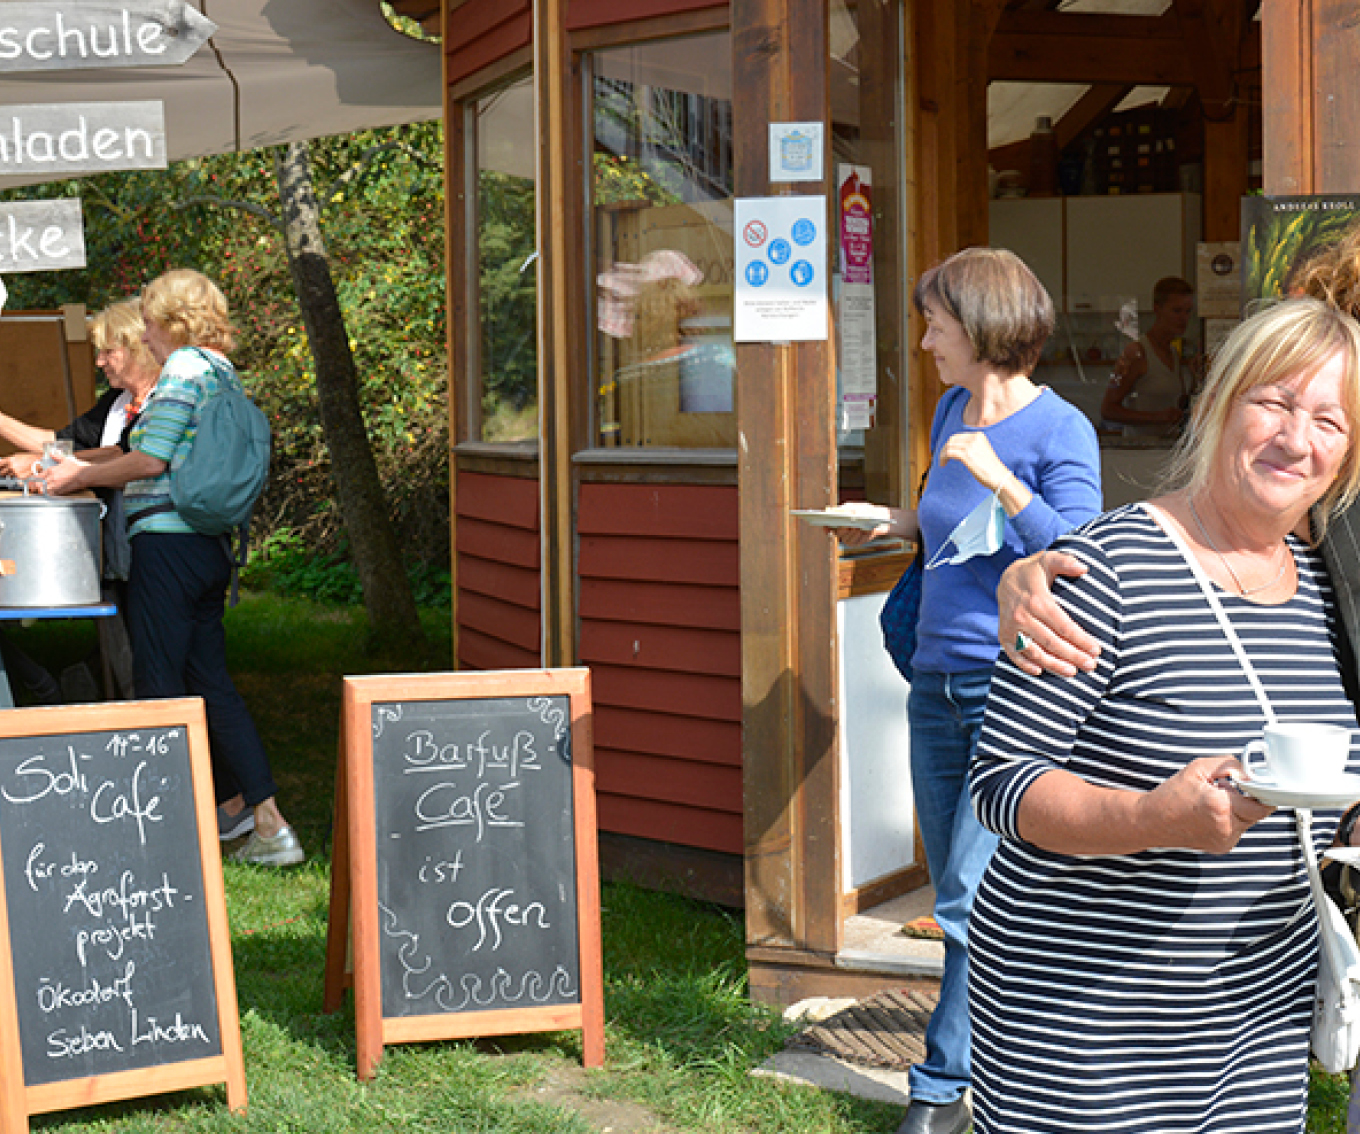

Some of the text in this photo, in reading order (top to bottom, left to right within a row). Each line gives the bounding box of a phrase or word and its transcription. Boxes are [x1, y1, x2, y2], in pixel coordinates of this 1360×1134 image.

[0, 8, 167, 60] schule
[0, 213, 71, 261] ke
[91, 760, 165, 846] Café
[415, 781, 521, 844] Café
[24, 842, 99, 892] für das
[418, 849, 465, 883] ist
[131, 1007, 211, 1046] Linden
